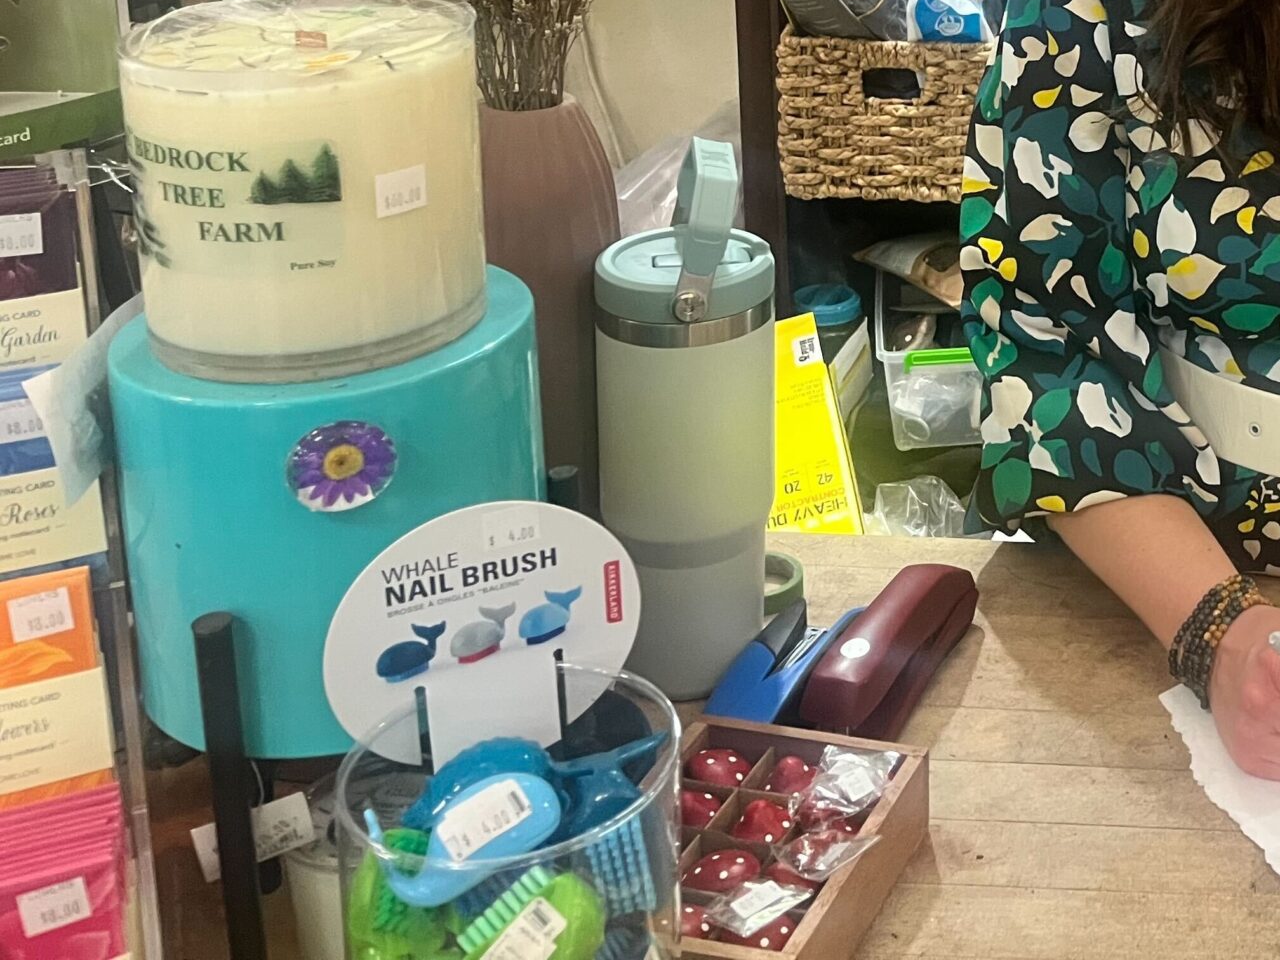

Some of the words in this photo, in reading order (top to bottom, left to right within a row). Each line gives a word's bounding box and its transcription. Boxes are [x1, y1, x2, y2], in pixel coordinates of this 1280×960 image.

[135, 136, 250, 172] BEDROCK
[158, 180, 226, 208] TREE
[197, 220, 286, 242] FARM
[290, 260, 315, 271] Pure
[317, 258, 336, 270] Soy
[12, 309, 41, 321] CARD
[2, 326, 59, 358] Garden
[25, 479, 56, 492] CARD
[784, 480, 802, 495] 20
[816, 472, 834, 486] 42
[4, 501, 60, 526] Roses
[767, 513, 788, 529] DU
[793, 496, 848, 522] HEAVY
[381, 552, 459, 584] WHALE
[384, 574, 454, 607] NAIL
[461, 547, 557, 587] BRUSH
[609, 564, 619, 620] KIKKERLAND
